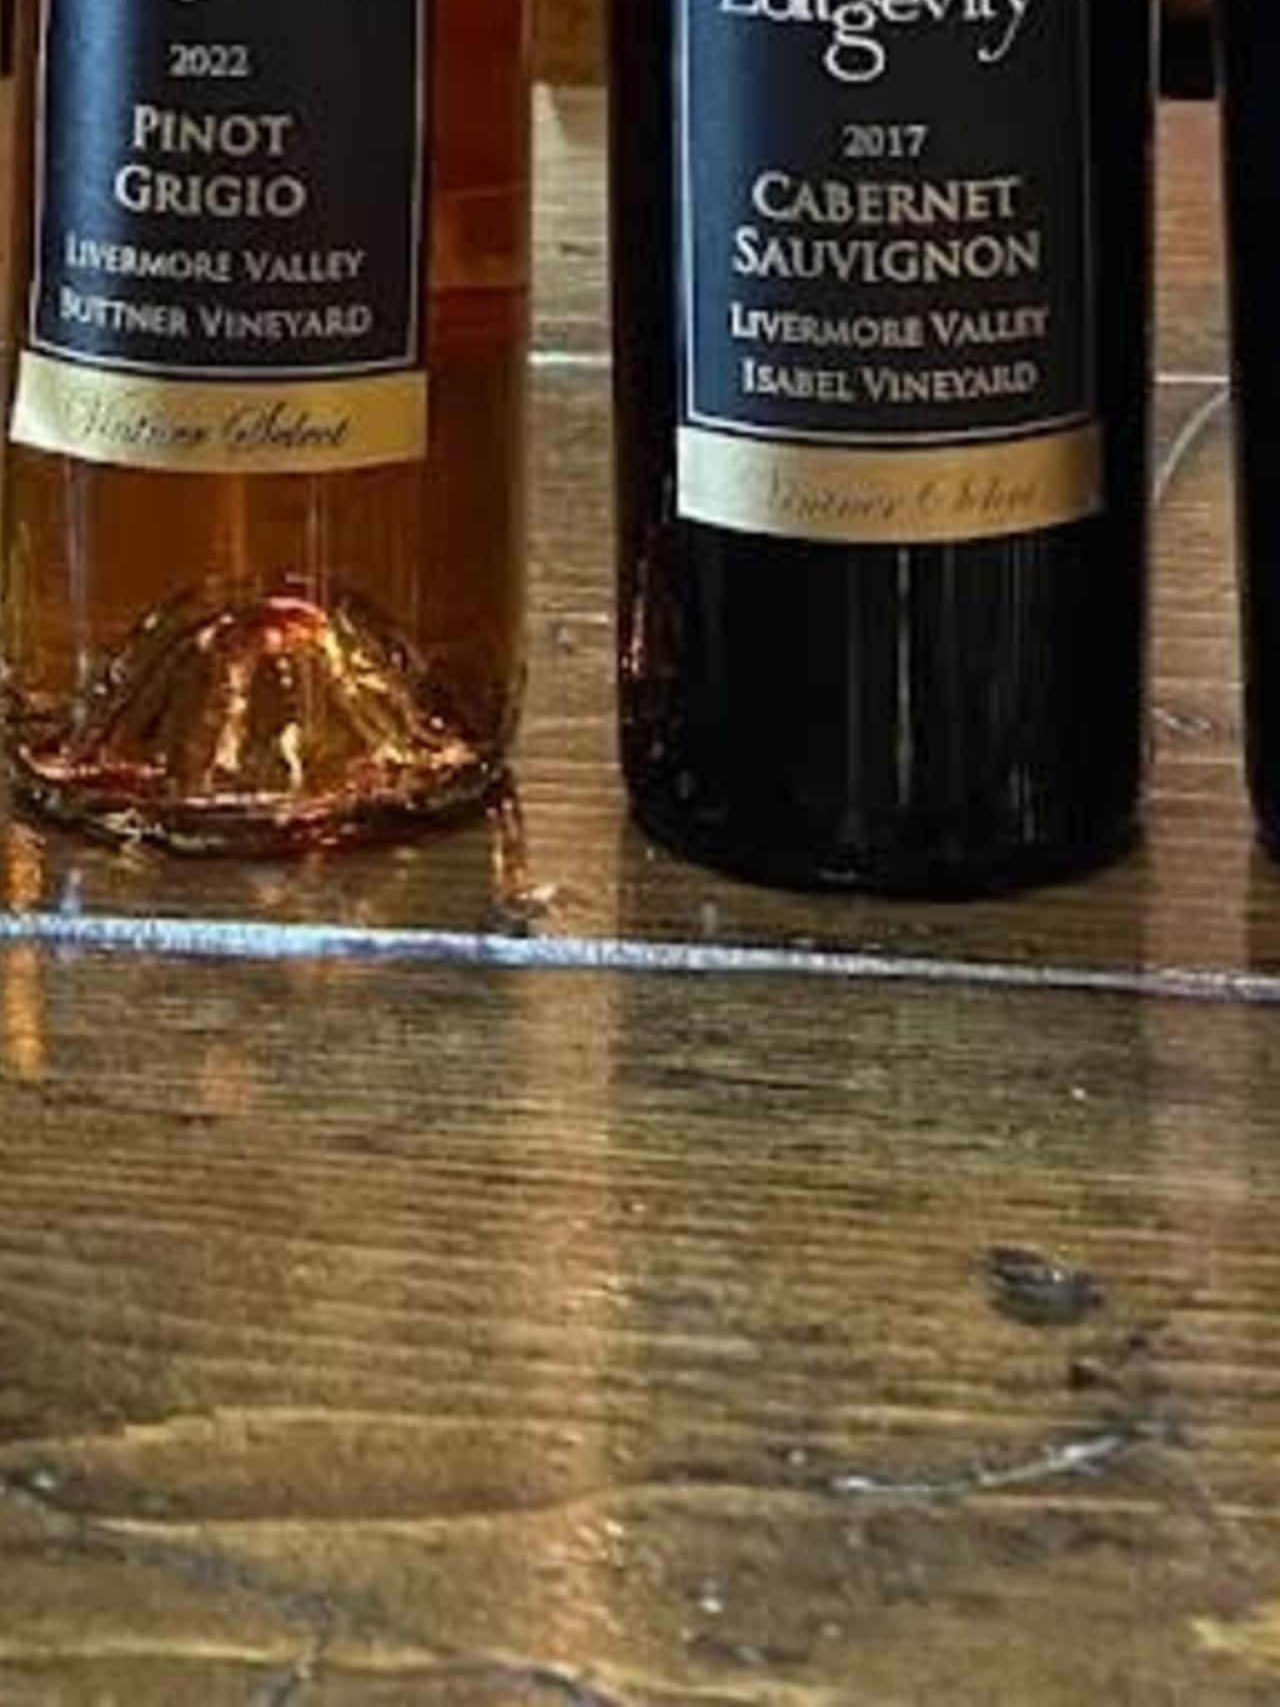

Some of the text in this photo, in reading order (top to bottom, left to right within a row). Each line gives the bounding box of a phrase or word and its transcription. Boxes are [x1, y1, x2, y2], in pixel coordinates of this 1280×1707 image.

[170, 43, 250, 78] 2022
[133, 104, 294, 158] PINOT
[844, 124, 928, 157] 2017
[115, 164, 307, 218] GRIGIO
[751, 171, 1023, 225] CABERNET
[65, 234, 368, 283] LIVERMORE VALLEY
[733, 227, 1042, 284] SAUVIGNON
[199, 303, 373, 338] VINEYARD
[730, 301, 1050, 348] LIVERMORE VALLEY
[741, 354, 1040, 404] ISABEL VINEYARD
